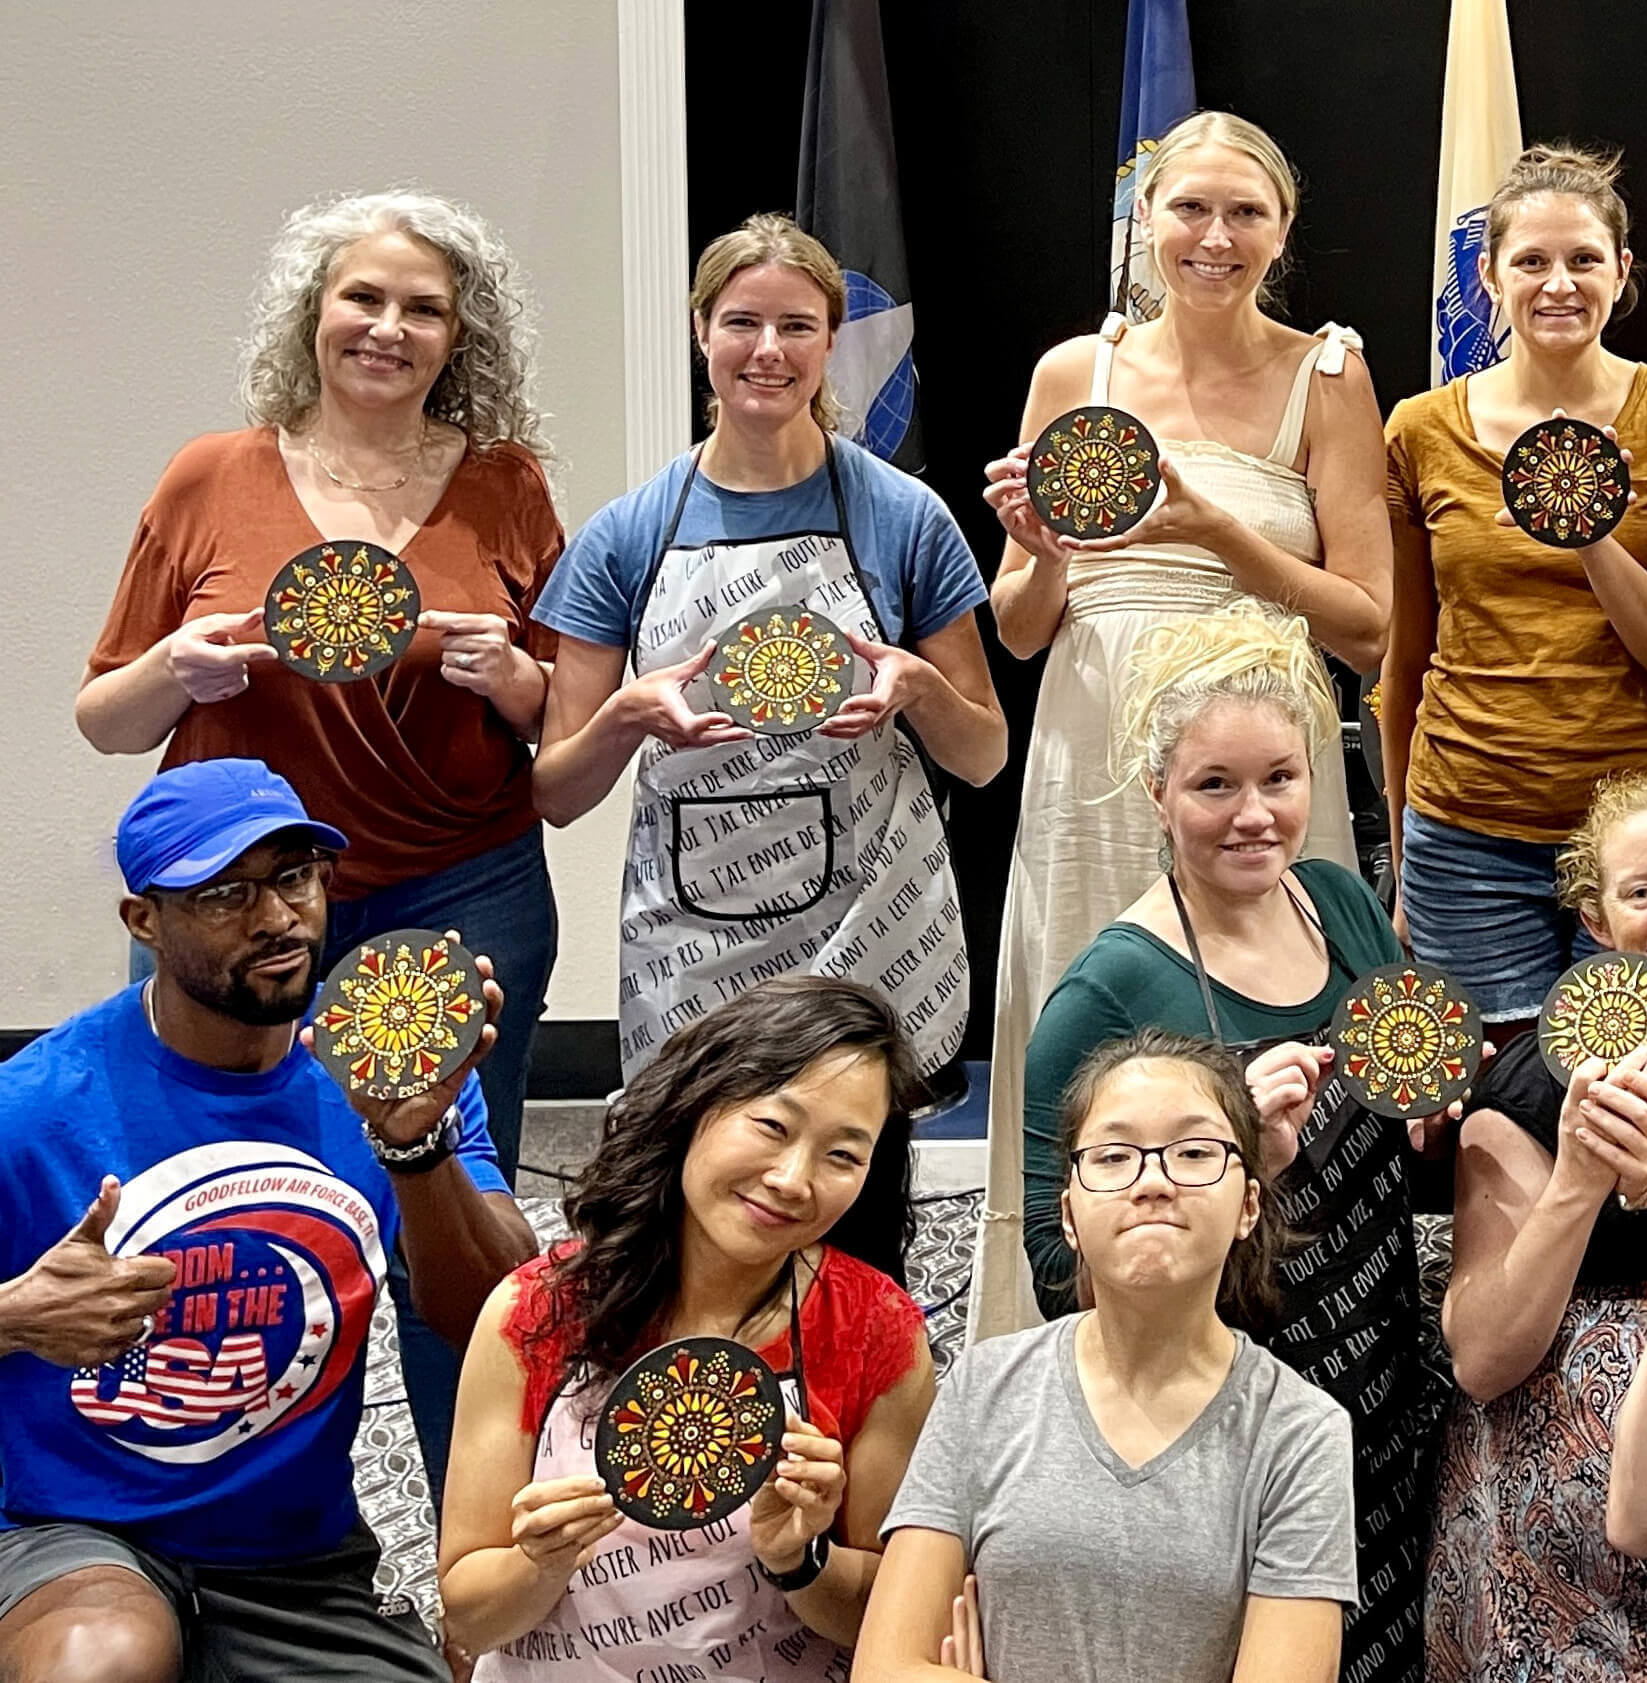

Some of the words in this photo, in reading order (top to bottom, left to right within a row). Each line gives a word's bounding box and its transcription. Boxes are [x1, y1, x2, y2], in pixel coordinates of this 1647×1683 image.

[649, 416, 920, 484] ARMY
[649, 609, 688, 650] LISANT
[694, 595, 717, 619] TA
[720, 567, 767, 608] LETTRE
[816, 581, 847, 612] J'AI
[701, 769, 725, 794] DE
[722, 750, 759, 783] RIRE
[704, 810, 740, 843] J'AI
[709, 860, 748, 894] J'AI
[747, 836, 798, 876] ENVIE
[797, 825, 821, 851] DE
[848, 788, 873, 826] AVEC
[870, 767, 889, 797] TOI
[867, 916, 890, 939] TA
[887, 878, 923, 923] LETTRE
[646, 956, 674, 989] J'AI
[677, 940, 704, 969] RIS
[709, 925, 744, 957] J'AI
[879, 948, 922, 993] RESTER
[917, 918, 946, 957] AVEC
[940, 895, 960, 926] TOI
[660, 993, 708, 1034] LETTRE
[712, 971, 747, 1004] J'AI
[749, 948, 800, 983] ENVIE
[901, 995, 938, 1037] VIVRE
[934, 967, 961, 1004] AVEC
[1311, 1100, 1330, 1132] DE
[184, 1176, 287, 1212] GOODFELLOW
[287, 1178, 309, 1194] AIR
[310, 1183, 349, 1208] FORCE
[1276, 1182, 1321, 1226] MAIS
[1321, 1159, 1344, 1193] EN
[1340, 1112, 1384, 1170] LISANT
[1279, 1241, 1330, 1286] TOUTE
[1327, 1224, 1349, 1253] LA
[1372, 1170, 1393, 1201] DE
[182, 1292, 218, 1334] IN
[226, 1283, 288, 1330] THE
[1317, 1286, 1357, 1330] J'AI
[1351, 1245, 1391, 1299] ENVIE
[1385, 1227, 1402, 1256] DE
[70, 1332, 271, 1431] USA
[1323, 1348, 1349, 1380] DE
[648, 1529, 696, 1567] AVEC
[700, 1516, 738, 1546] TOI
[1365, 1503, 1391, 1536] TOI
[1370, 1562, 1397, 1596] TOI
[580, 1615, 643, 1652] VIVRE
[646, 1595, 695, 1639] AVEC
[693, 1579, 734, 1613] TOI
[1385, 1618, 1405, 1647] TU
[708, 1642, 732, 1671] TU
